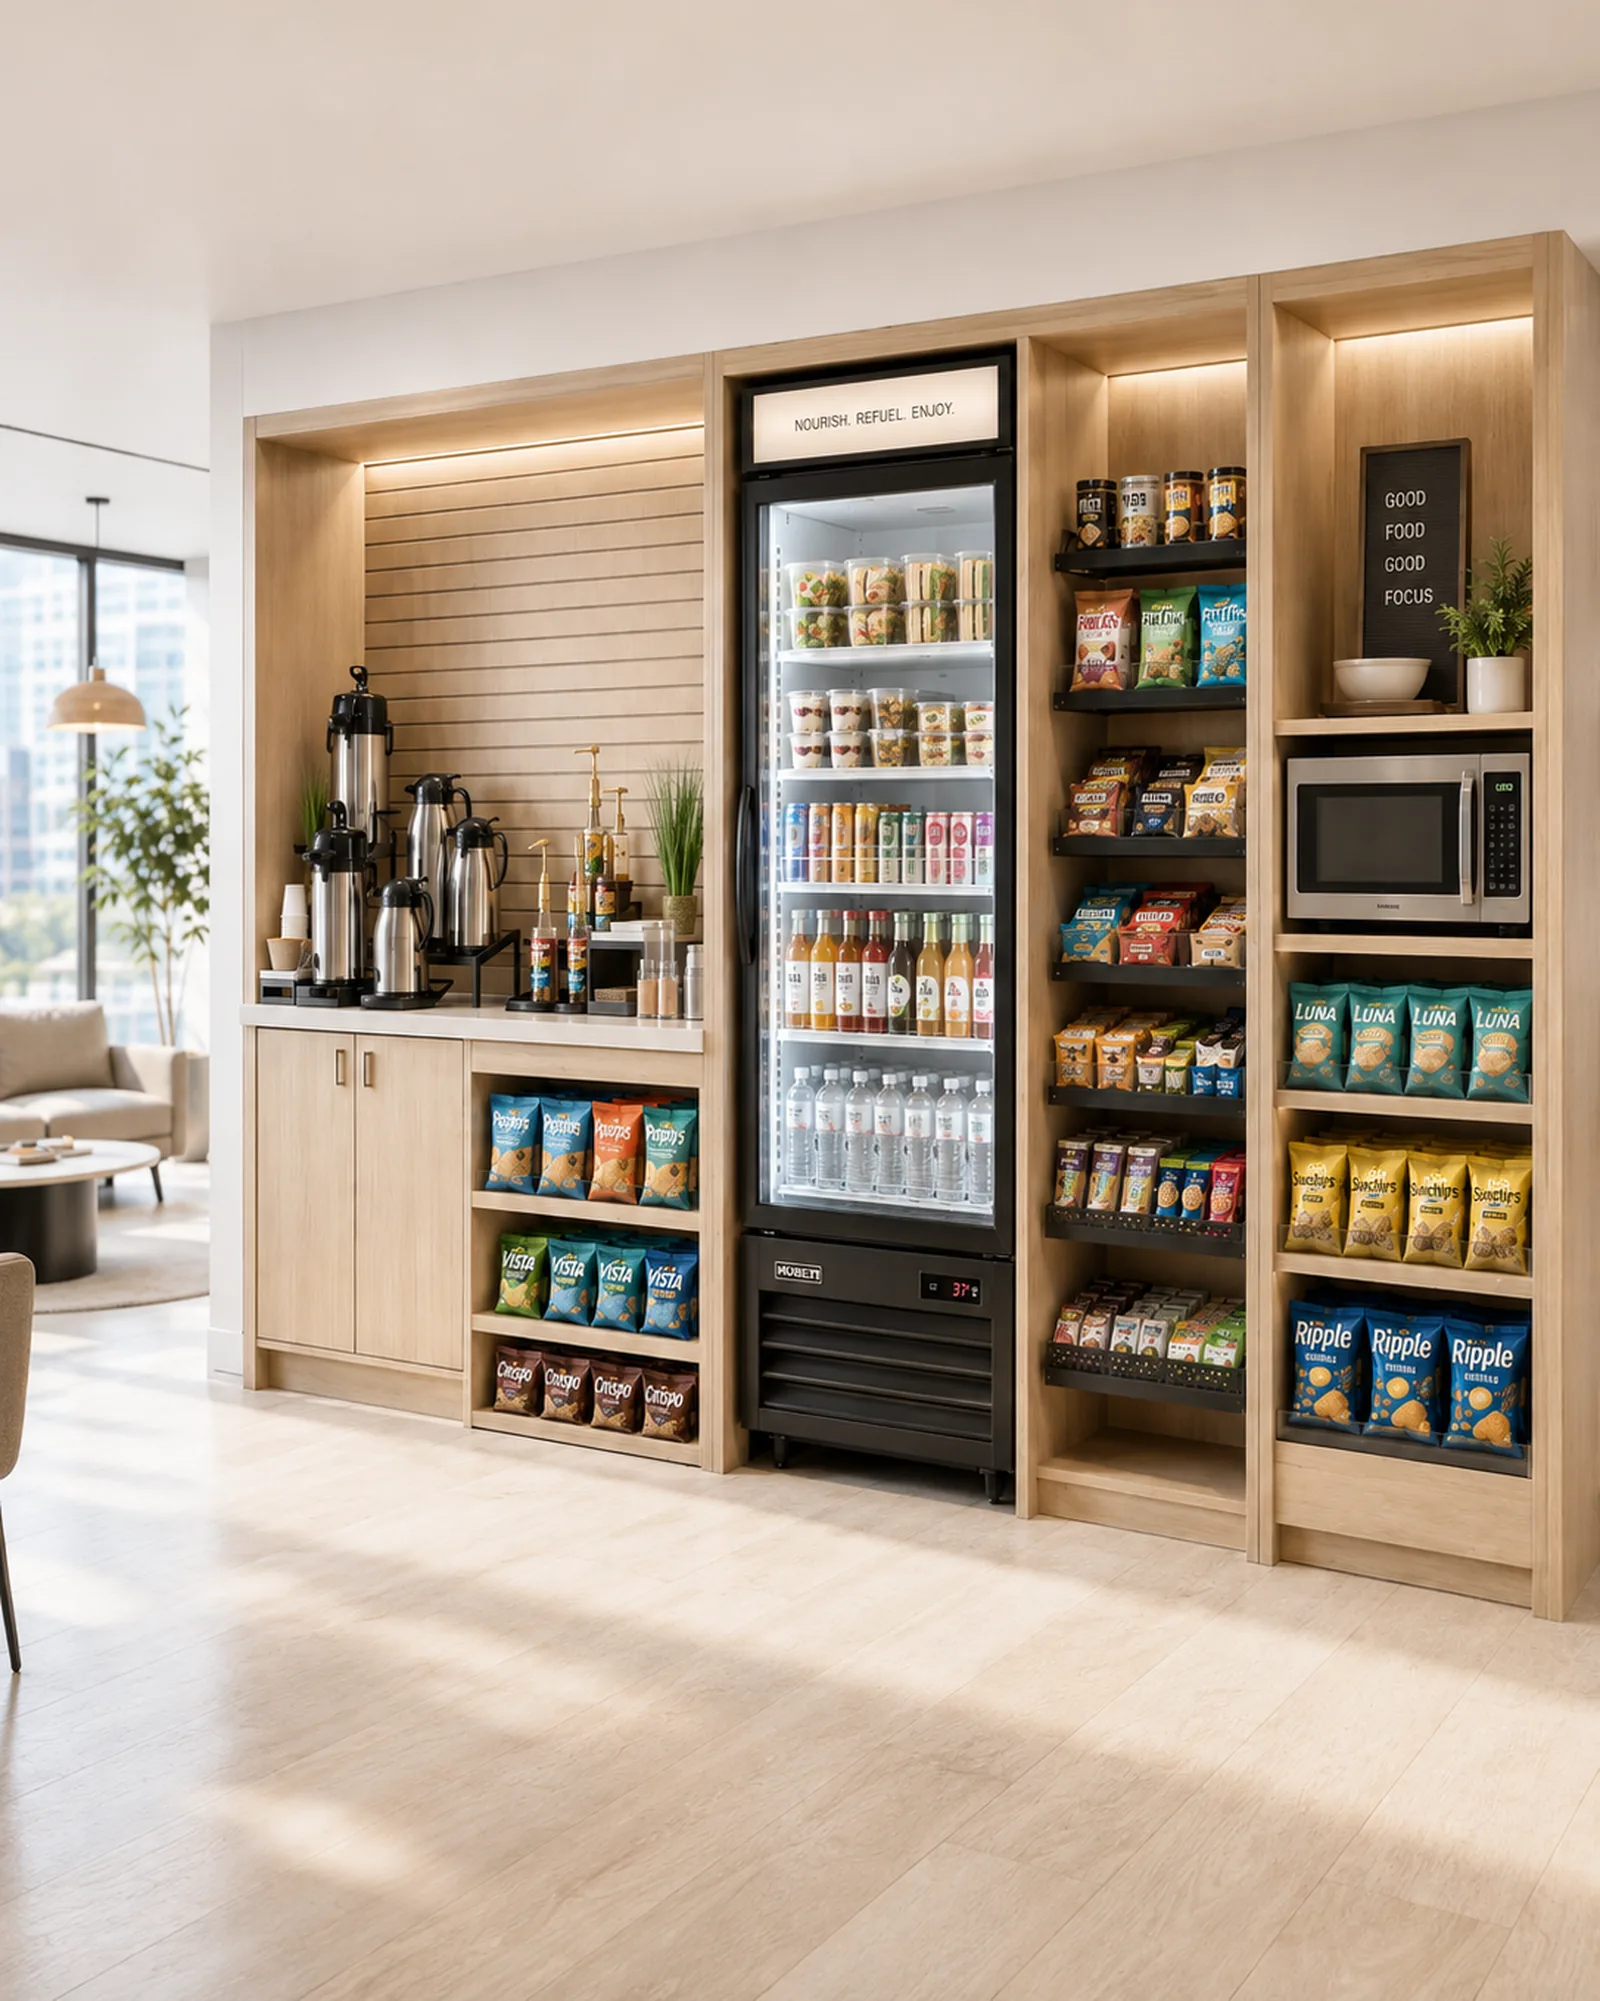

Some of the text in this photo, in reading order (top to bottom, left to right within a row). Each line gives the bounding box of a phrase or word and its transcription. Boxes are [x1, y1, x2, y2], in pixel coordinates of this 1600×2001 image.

[794, 401, 955, 432] NOURISH. REFUEL. ENJOY.
[1385, 490, 1426, 508] GOOD
[1385, 522, 1425, 540] FOOD
[1385, 555, 1425, 572] GOOD
[1384, 588, 1433, 605] FOCUS
[1294, 1003, 1336, 1021] LUNA
[1353, 1005, 1395, 1024] LUNA
[1412, 1007, 1456, 1026] LUNA
[1475, 1010, 1520, 1029] LUNA
[503, 1250, 536, 1273] VISTA
[552, 1256, 586, 1278] VISTA
[600, 1261, 634, 1283] VISTA
[648, 1267, 683, 1291] VISTA
[1294, 1320, 1352, 1351] Ripple
[1371, 1327, 1432, 1360] Ripple
[1451, 1338, 1513, 1371] Ripple
